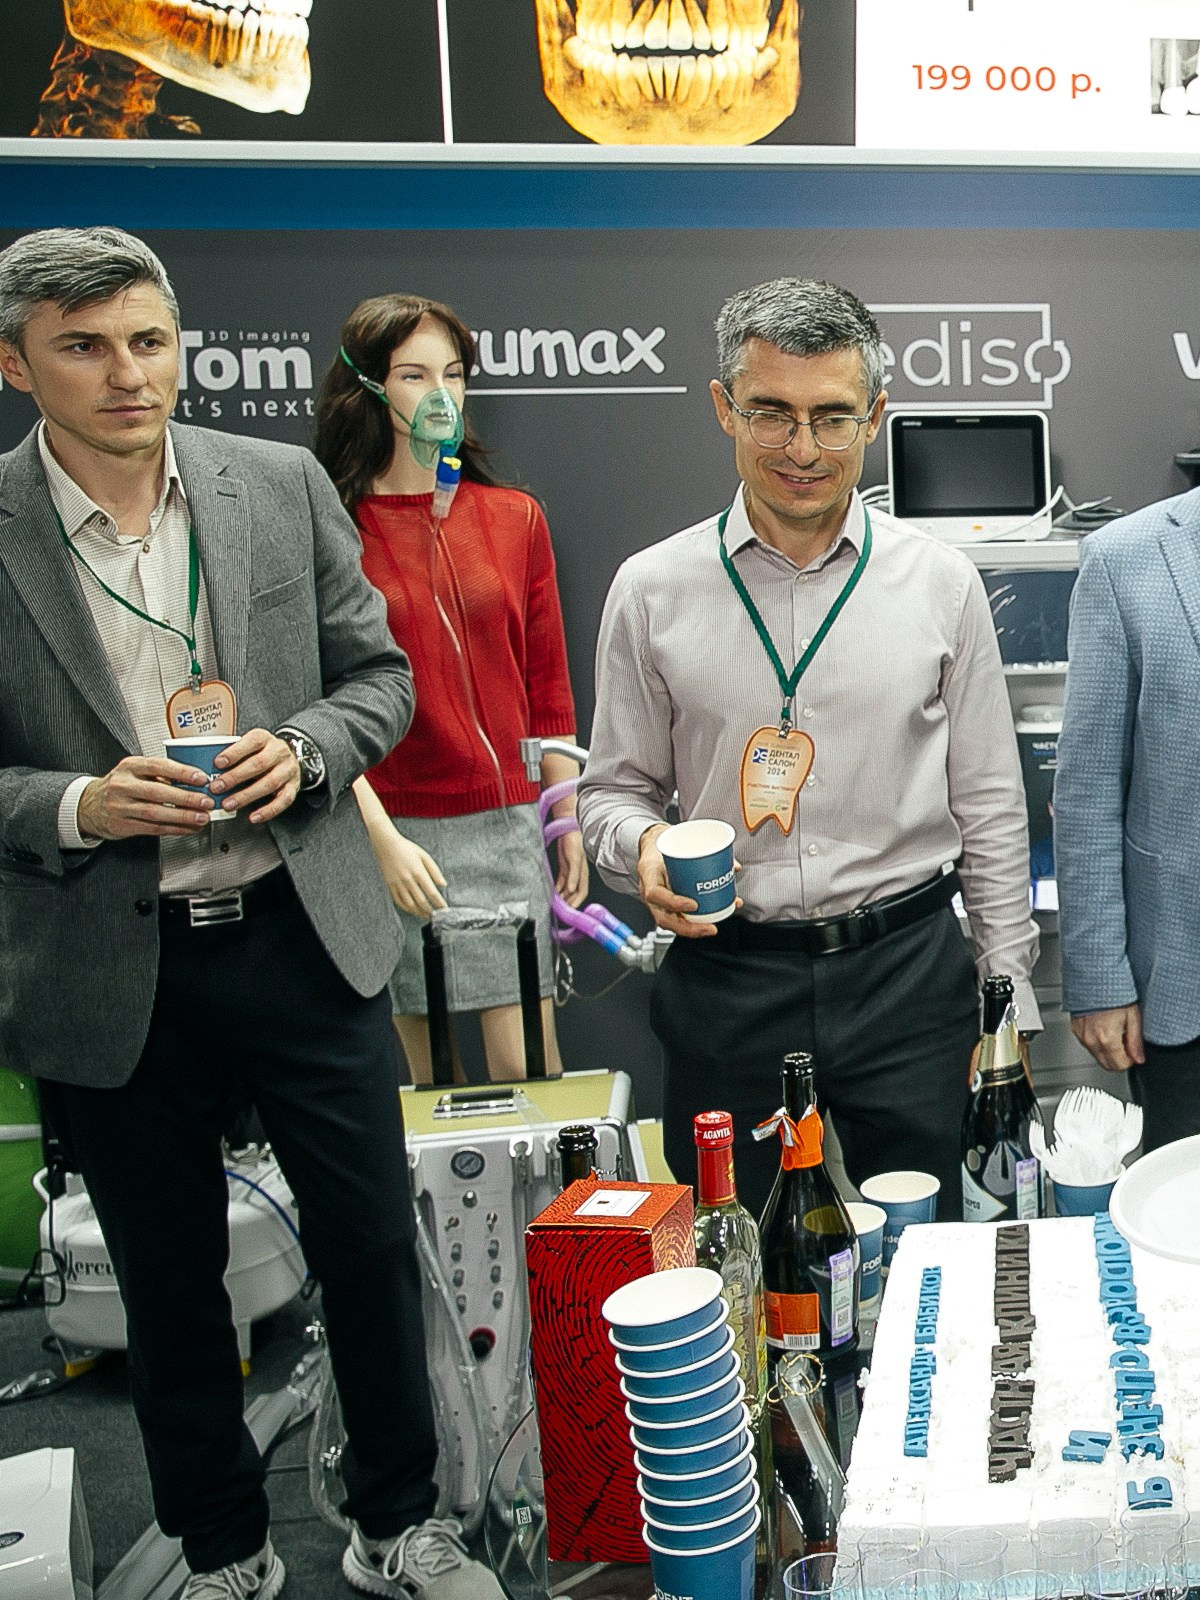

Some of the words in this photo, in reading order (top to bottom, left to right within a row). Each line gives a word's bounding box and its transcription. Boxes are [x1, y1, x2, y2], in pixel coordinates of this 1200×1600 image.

[912, 64, 971, 90] 199
[985, 65, 1056, 92] 000
[238, 329, 311, 344] imaging
[241, 397, 315, 417] next
[193, 702, 223, 717] ДЕНТАЛ
[195, 711, 222, 725] САЛОН
[197, 722, 217, 734] 2024
[769, 749, 800, 760] ДЕНТАЛ
[767, 758, 796, 768] САЛОН
[766, 767, 787, 776] 2024
[994, 1223, 1036, 1343] КЛИНИКА
[914, 1265, 942, 1344] БАБИКОВ
[903, 1346, 937, 1457] АЛЕКСАНДР
